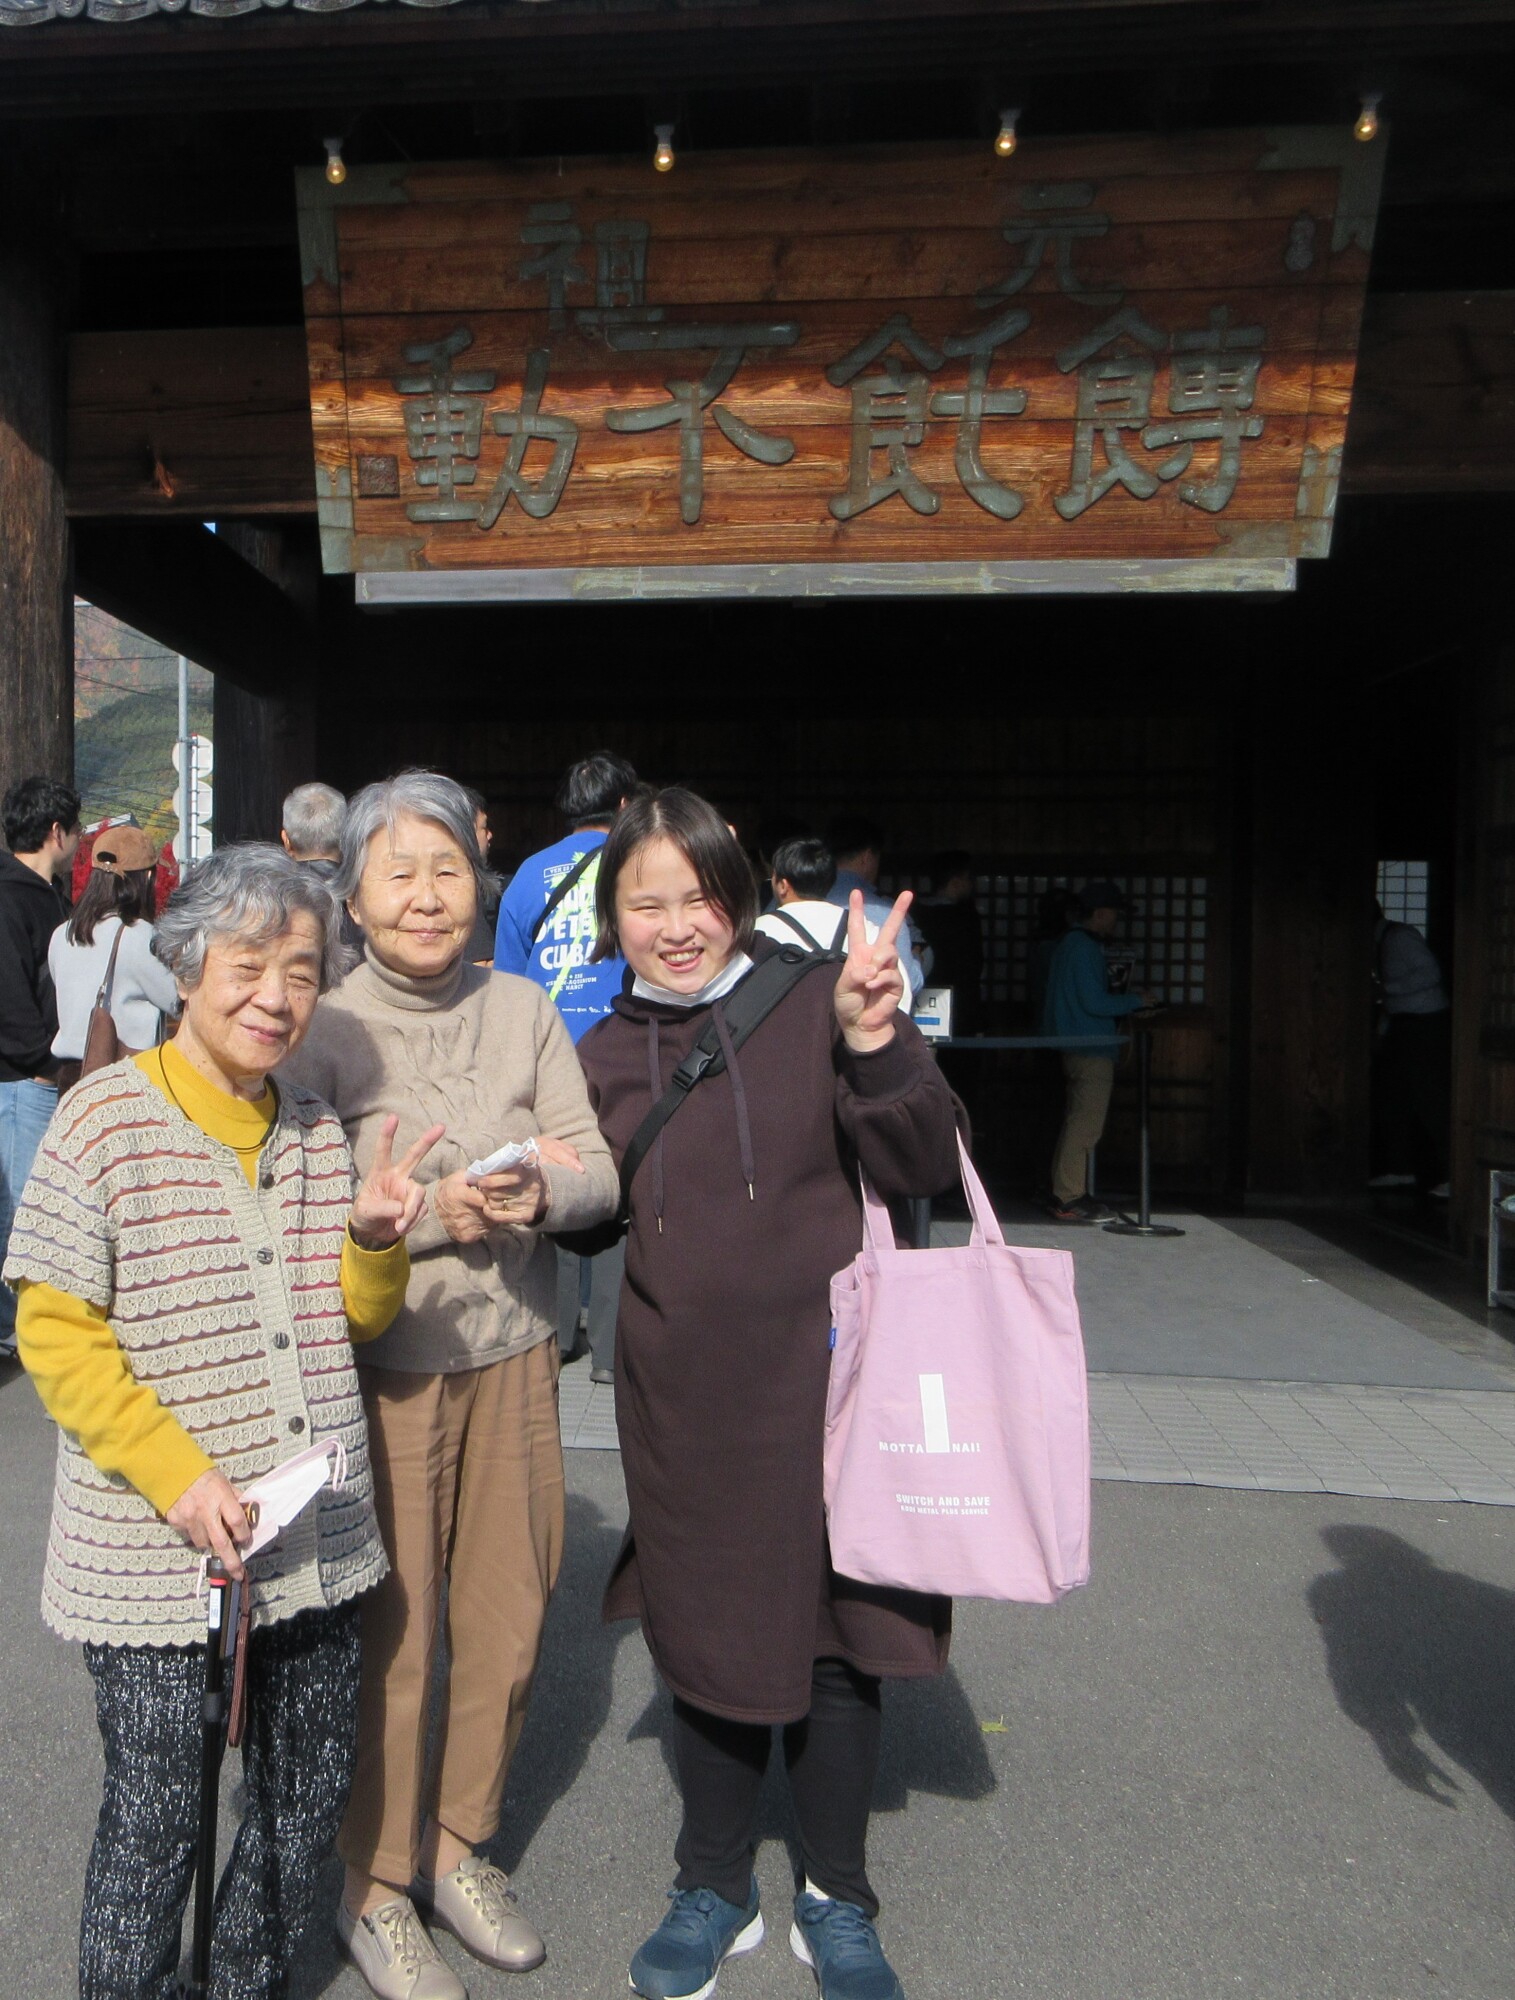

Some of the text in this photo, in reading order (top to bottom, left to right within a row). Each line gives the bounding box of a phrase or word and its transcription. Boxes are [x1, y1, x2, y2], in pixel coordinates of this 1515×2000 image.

[895, 1493, 991, 1506] SWITCH AND SAVE
